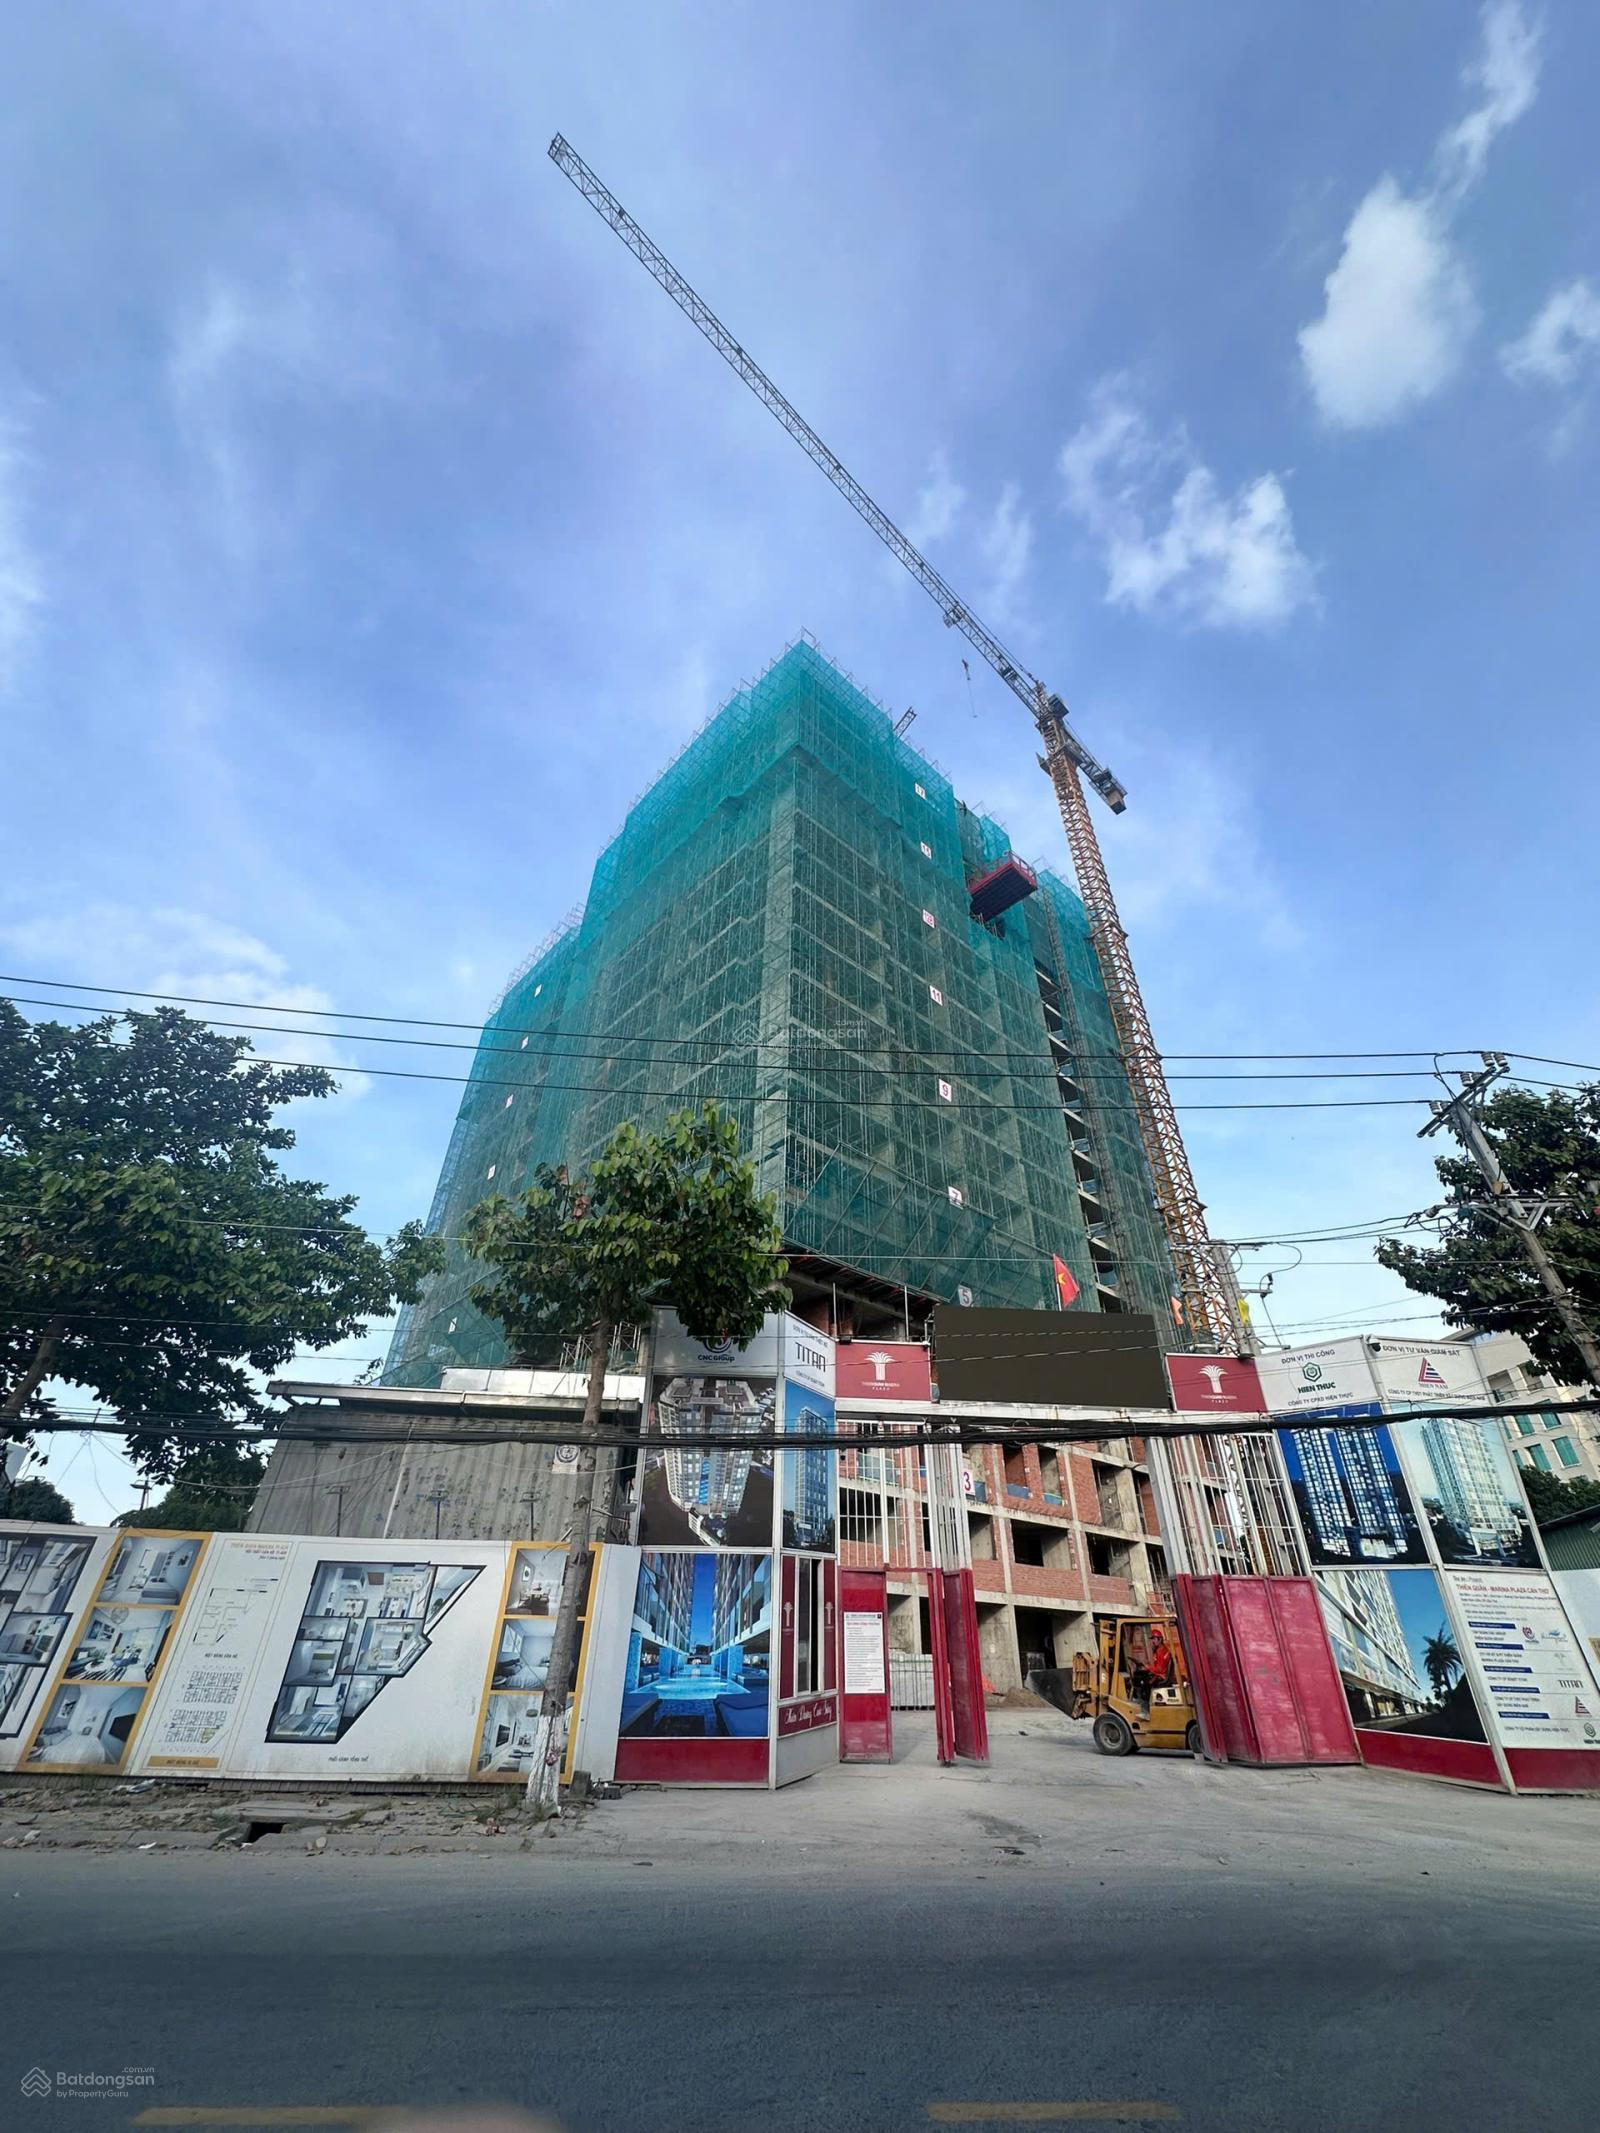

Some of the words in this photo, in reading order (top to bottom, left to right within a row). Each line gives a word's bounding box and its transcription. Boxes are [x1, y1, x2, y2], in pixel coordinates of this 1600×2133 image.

[942, 1083, 949, 1097] 9
[961, 1290, 971, 1305] 5
[795, 1341, 826, 1373] TITAN
[963, 1471, 972, 1491] 3
